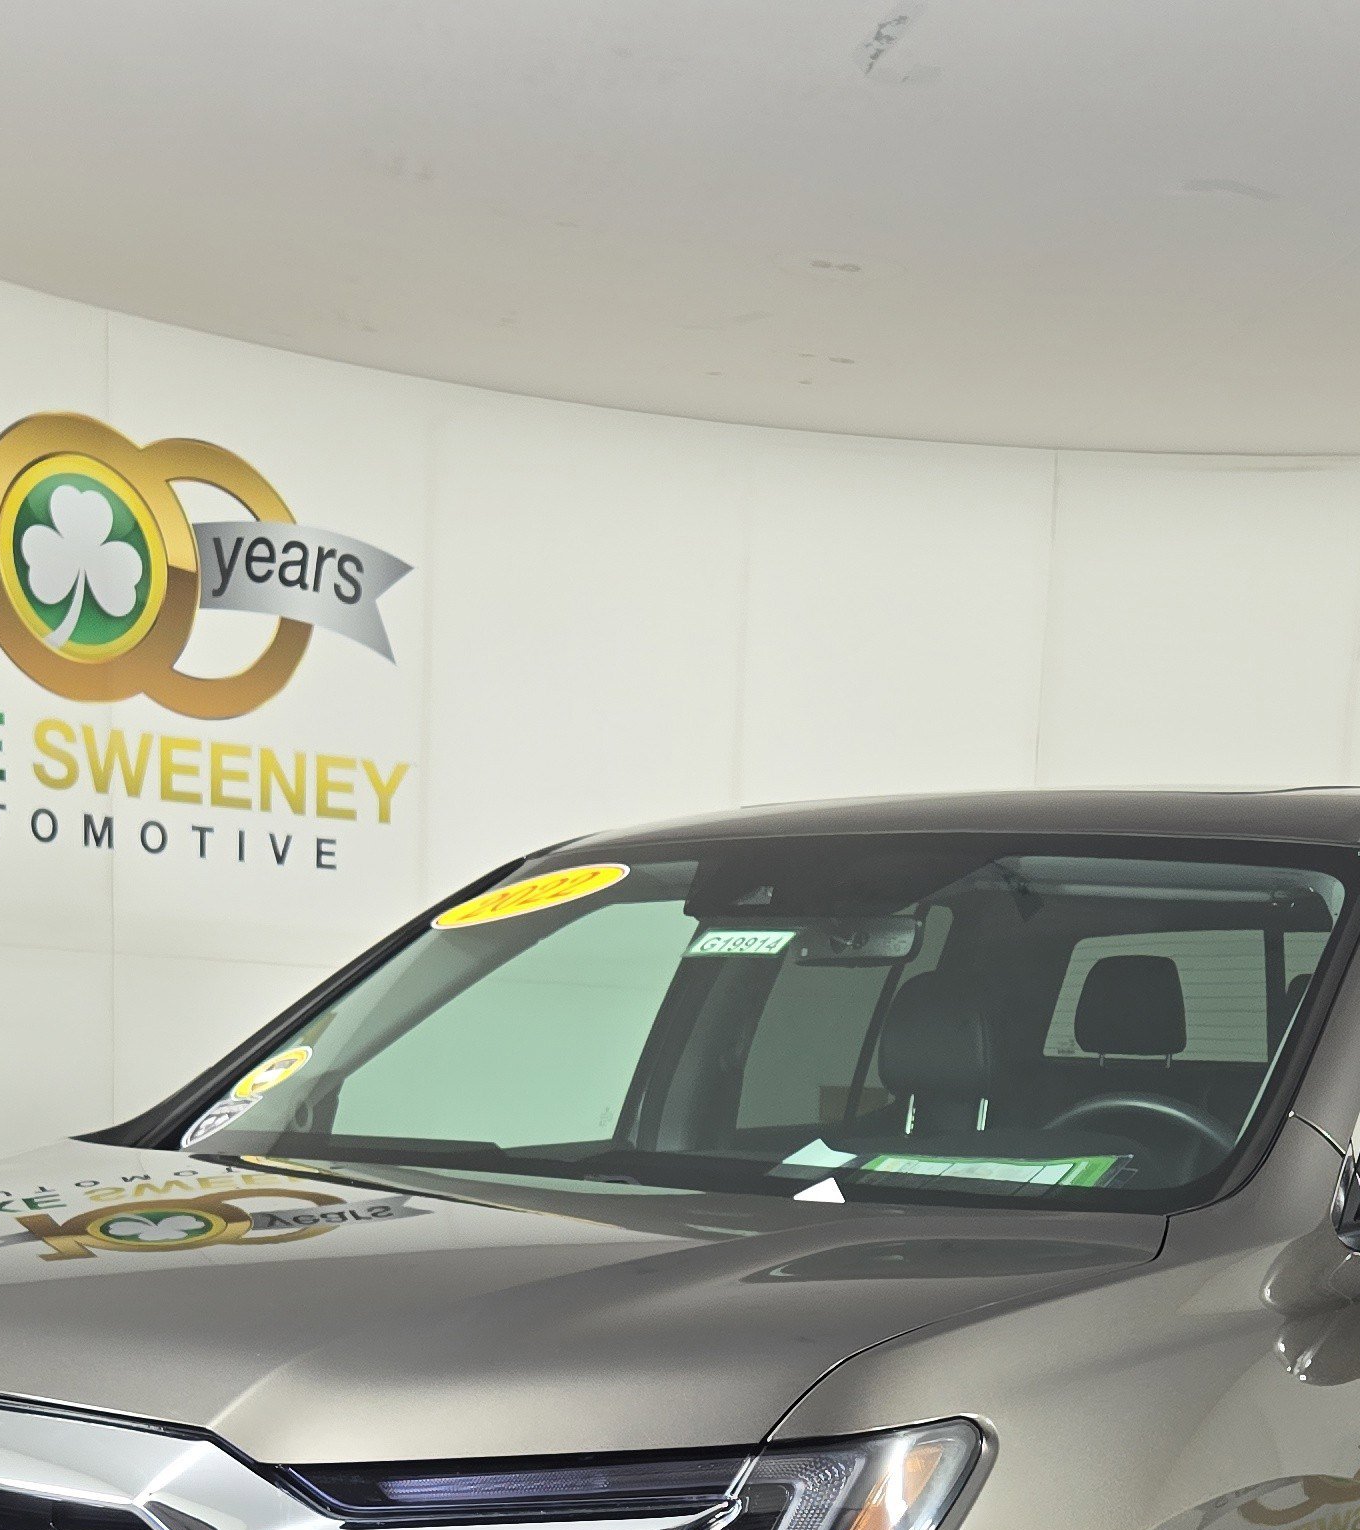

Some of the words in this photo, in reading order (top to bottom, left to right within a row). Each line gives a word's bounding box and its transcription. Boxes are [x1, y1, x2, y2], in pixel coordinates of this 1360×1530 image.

[211, 535, 365, 605] years
[32, 719, 410, 825] SWEENEY
[456, 871, 601, 921] 2022
